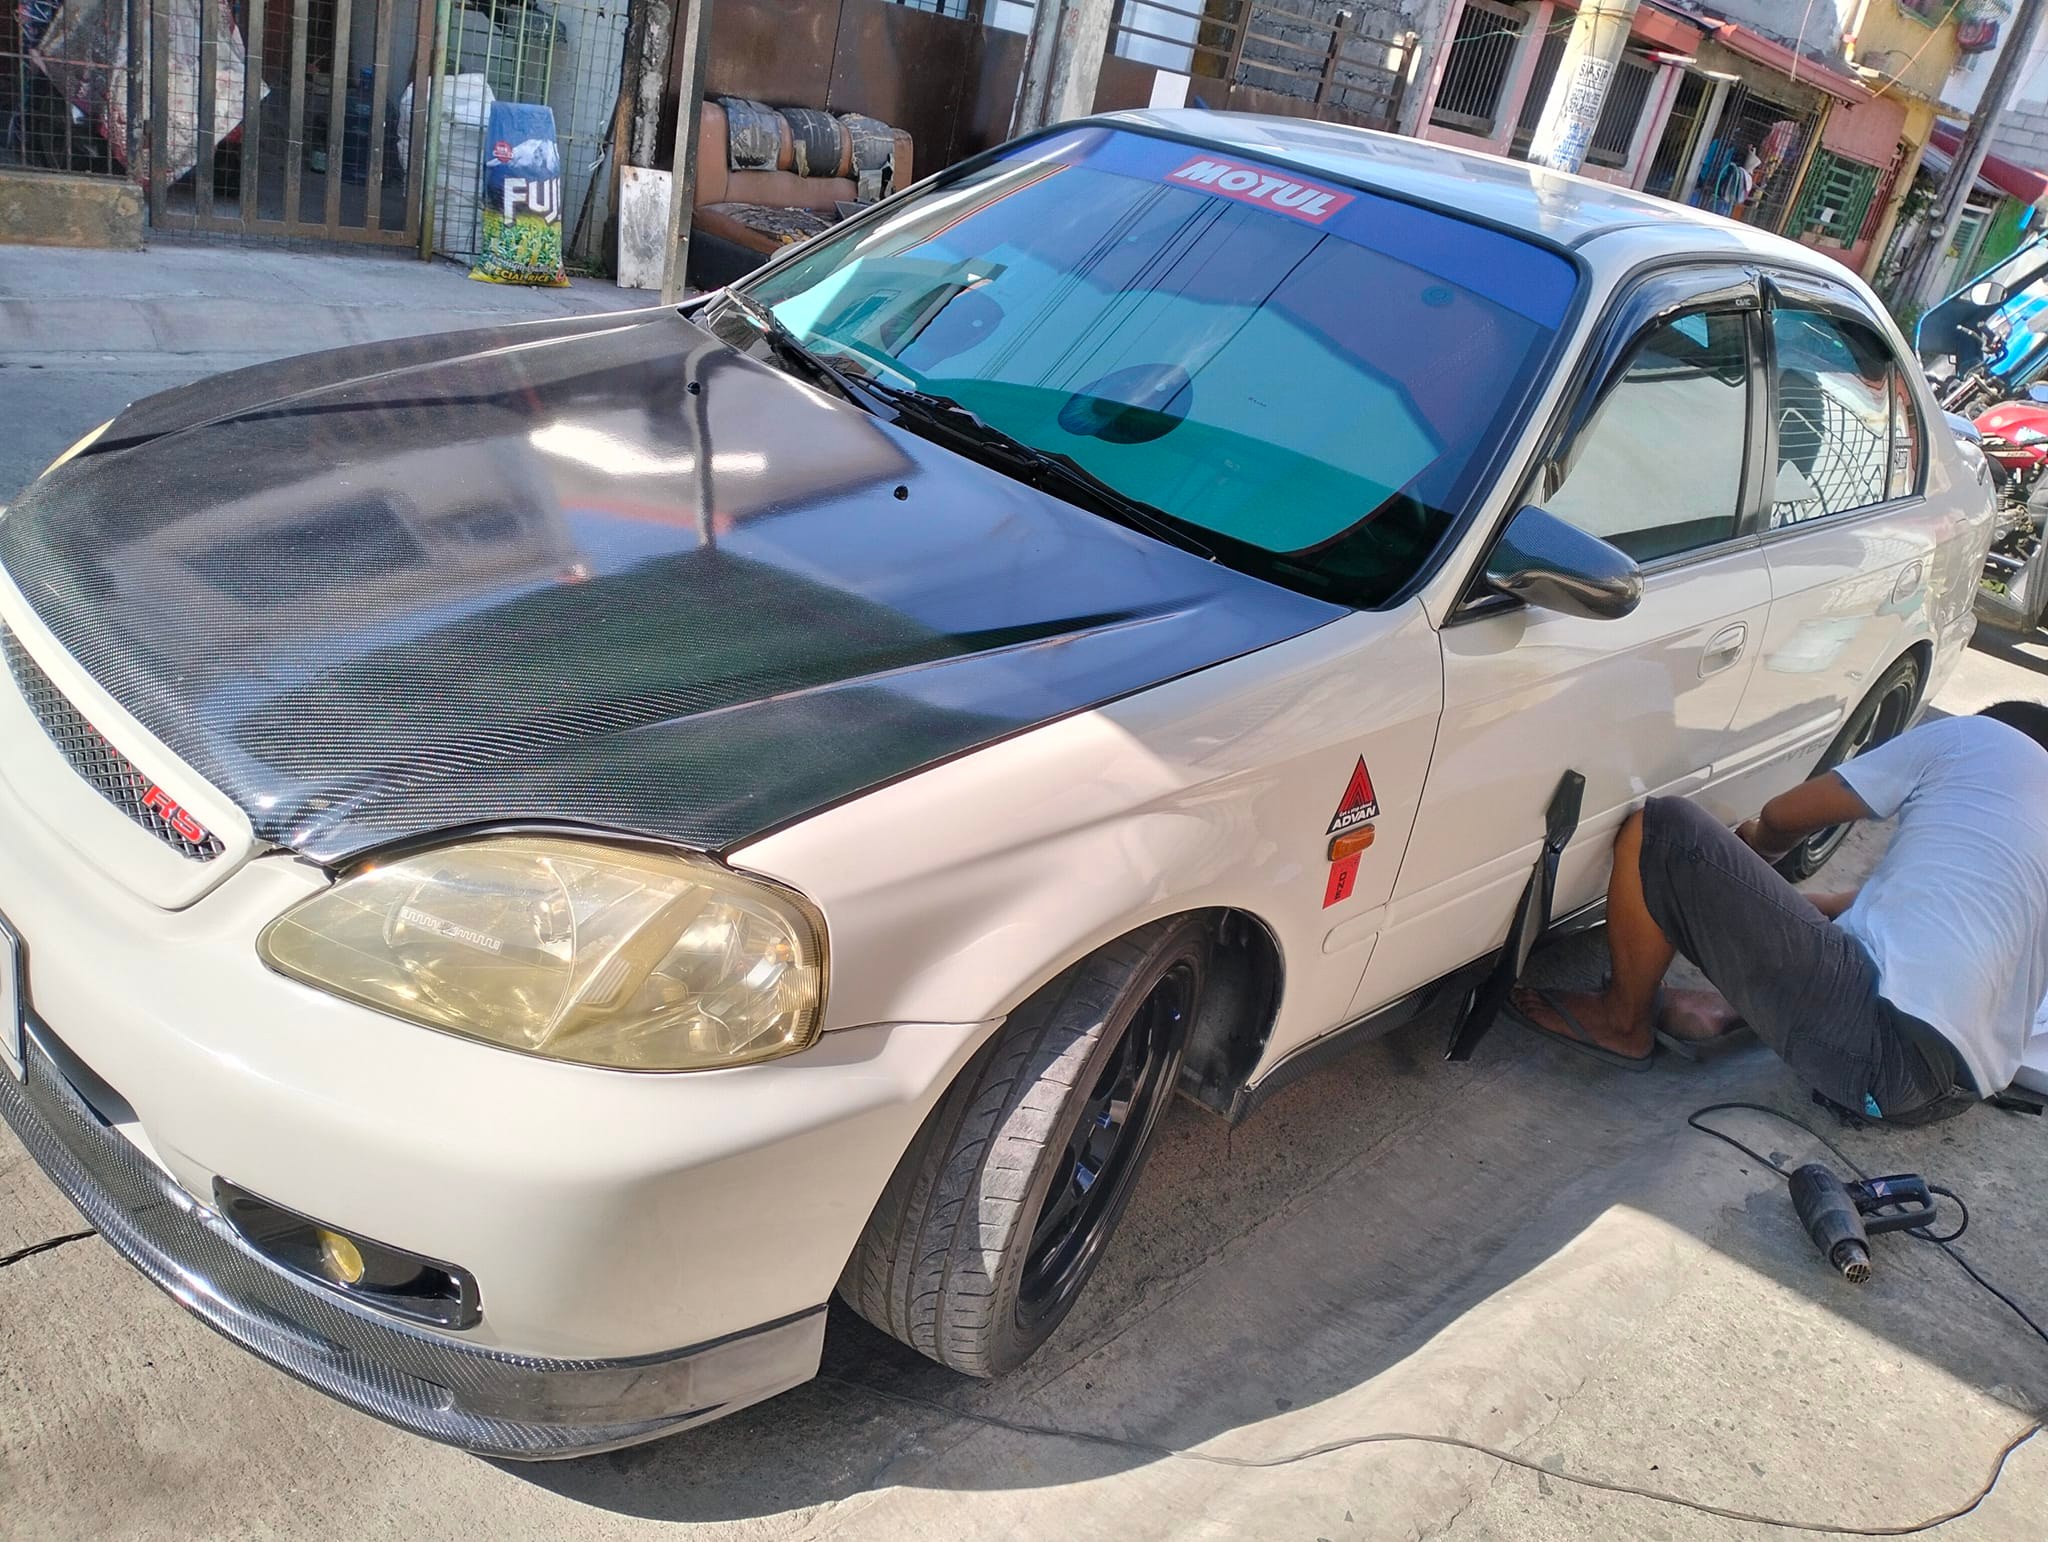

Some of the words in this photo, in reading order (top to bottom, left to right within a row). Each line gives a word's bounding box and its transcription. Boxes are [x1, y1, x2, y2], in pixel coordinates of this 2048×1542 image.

[1173, 161, 1336, 216] MOTUL
[484, 261, 524, 281] SPECIAL
[527, 273, 551, 283] RICE
[142, 784, 205, 844] RS
[1332, 805, 1376, 830] ADVAN
